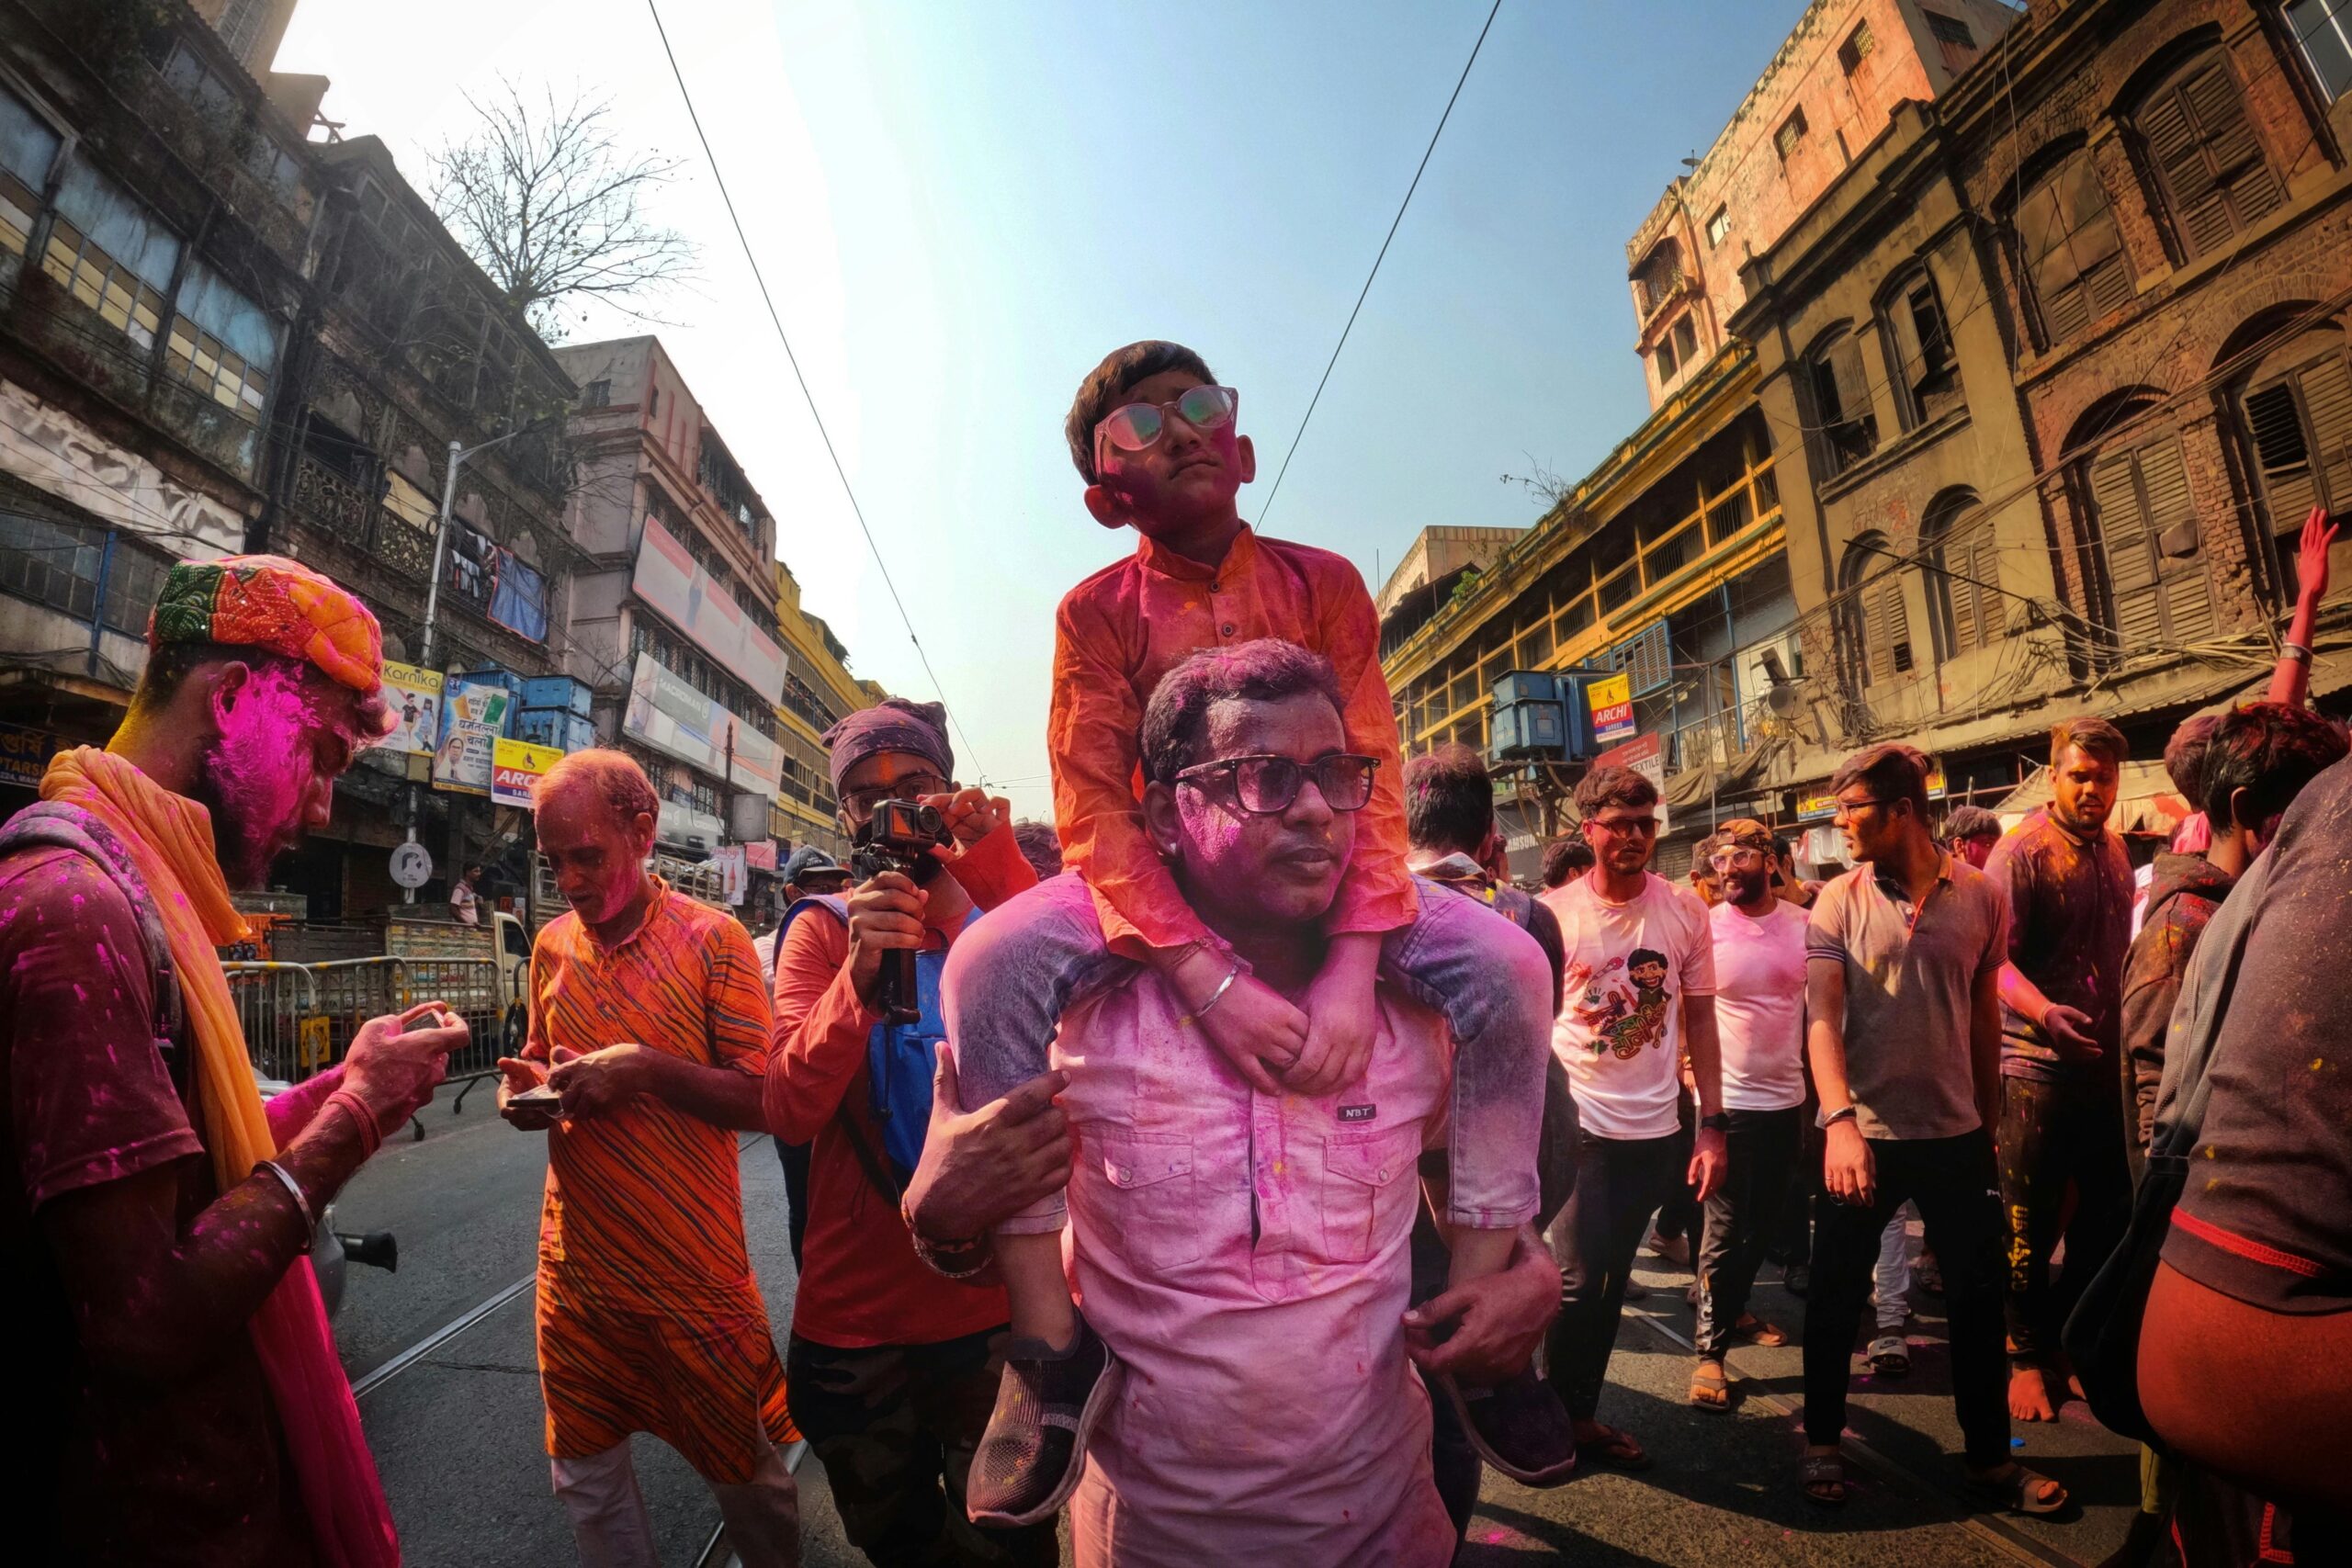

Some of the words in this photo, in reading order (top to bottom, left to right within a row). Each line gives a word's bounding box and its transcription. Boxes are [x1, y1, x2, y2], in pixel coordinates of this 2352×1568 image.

[383, 663, 439, 689] Karnika
[659, 677, 701, 712] MACROMAN
[1595, 704, 1627, 725] ARCHI
[458, 718, 500, 736] धर्मतल्ला
[496, 770, 537, 788] ARC
[1345, 1108, 1370, 1118] NBT
